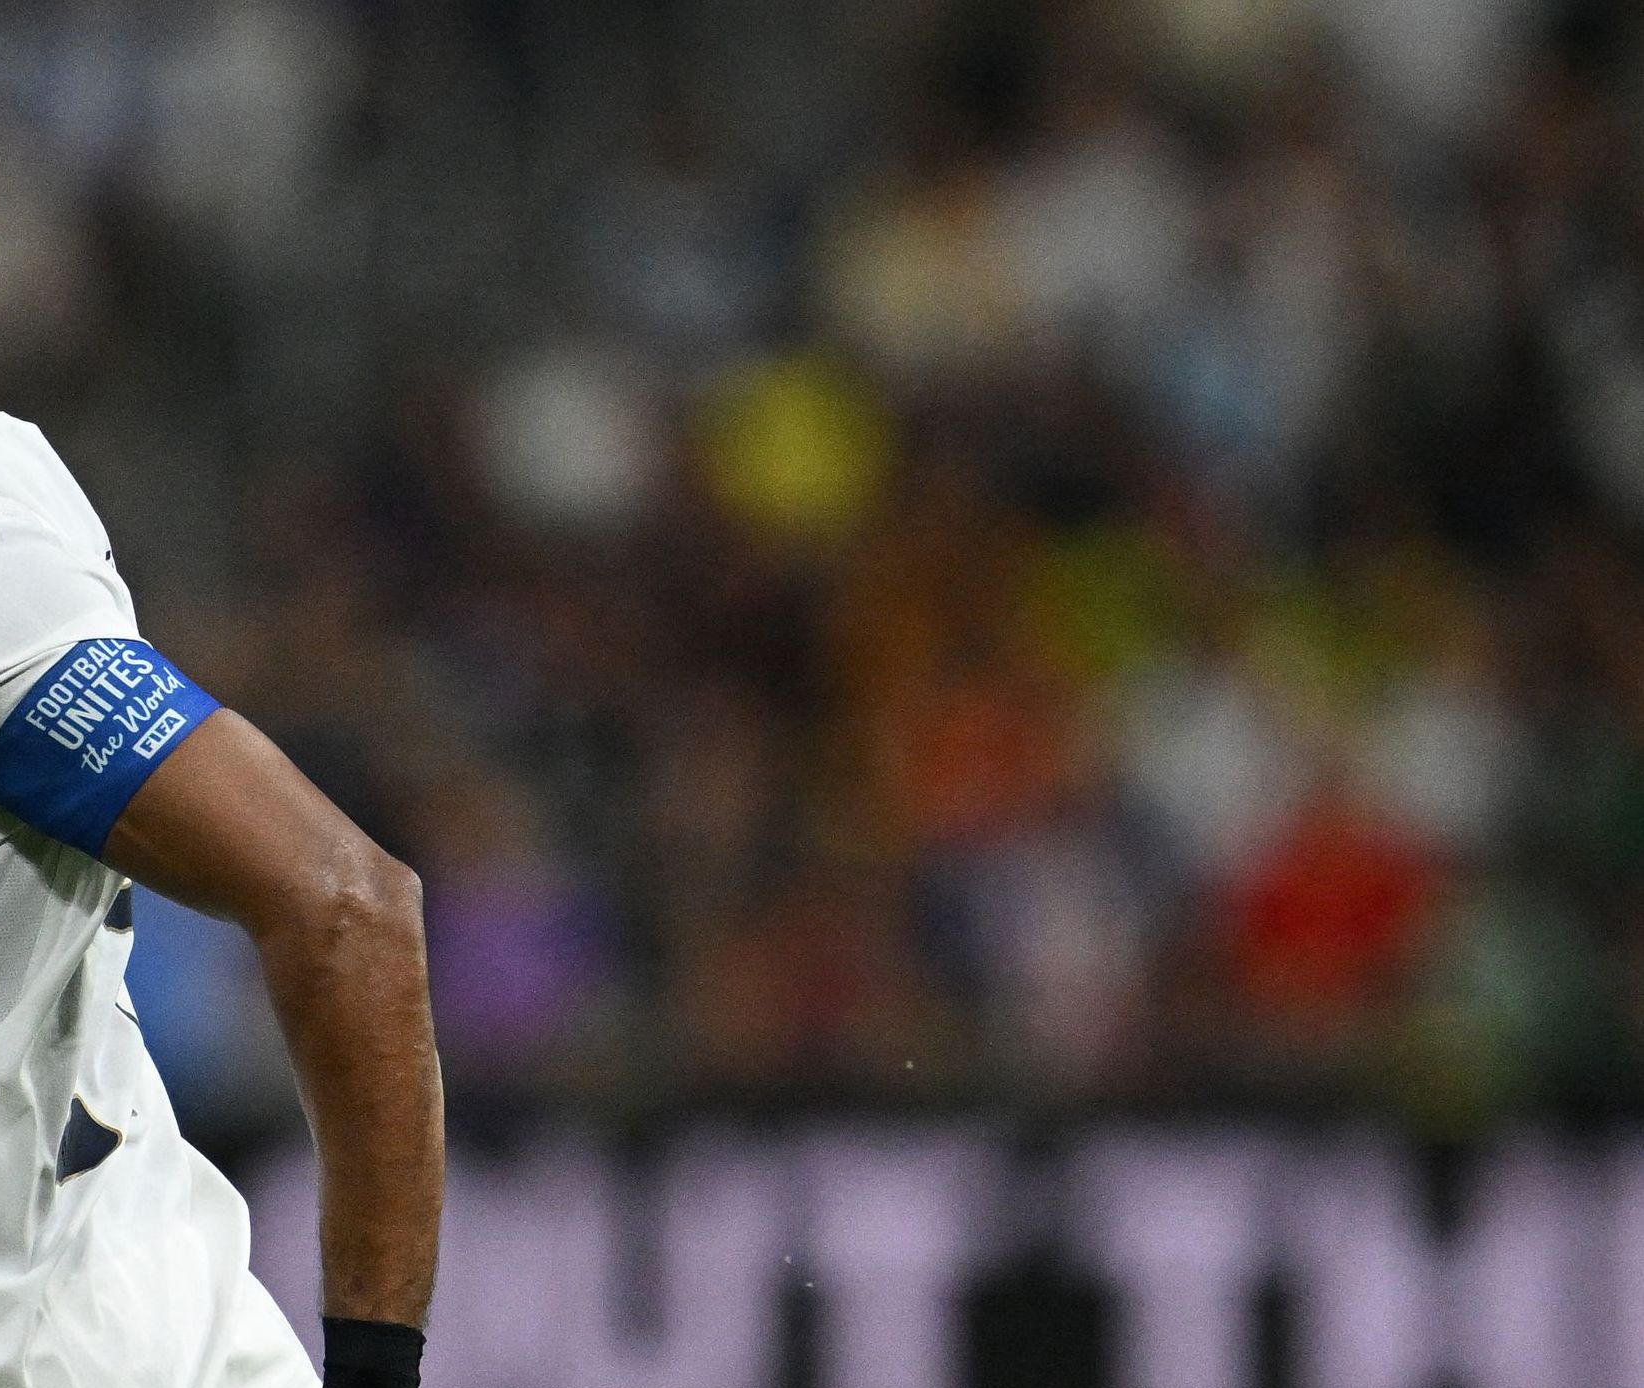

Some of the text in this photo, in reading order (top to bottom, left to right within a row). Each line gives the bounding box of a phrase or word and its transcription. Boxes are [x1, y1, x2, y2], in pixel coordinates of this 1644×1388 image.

[48, 650, 153, 750] UNITES
[81, 667, 185, 774] the World
[136, 712, 184, 757] FIFA
